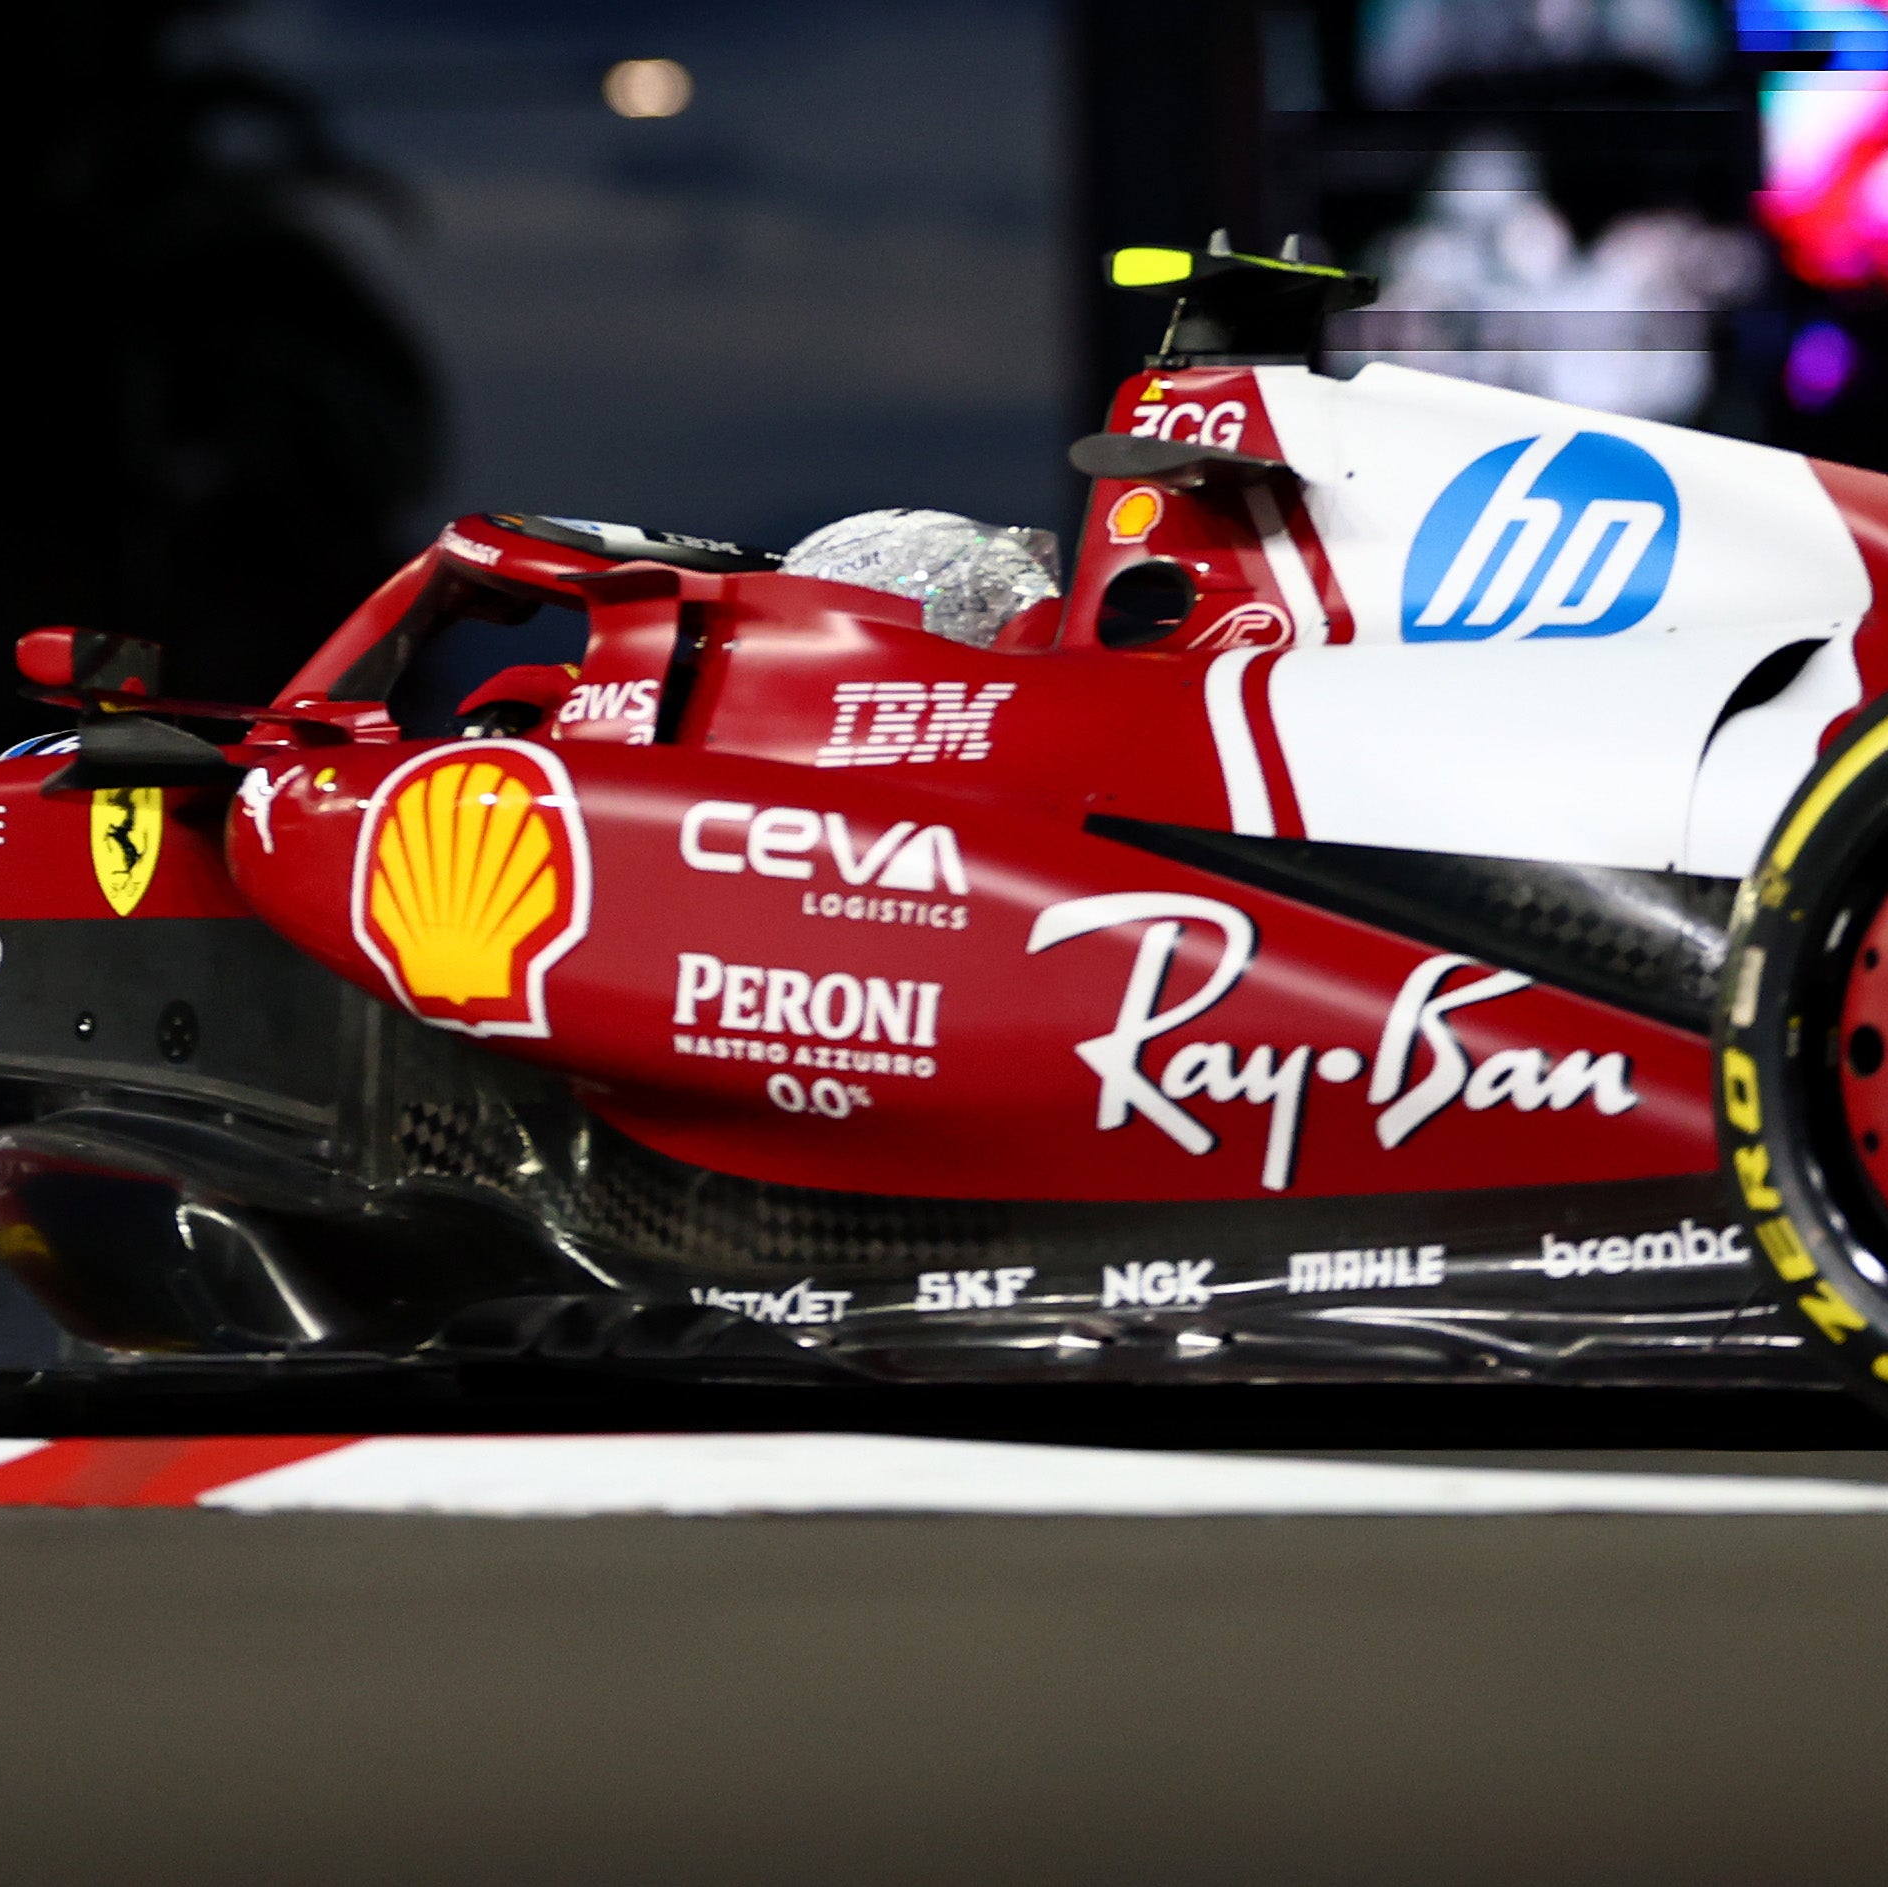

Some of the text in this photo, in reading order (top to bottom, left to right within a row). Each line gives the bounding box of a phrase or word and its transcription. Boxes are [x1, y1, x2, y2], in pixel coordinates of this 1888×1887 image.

[1413, 431, 1667, 643] hp
[559, 678, 660, 724] aws
[814, 682, 1018, 768] IBM
[801, 891, 970, 931] LOGISTICS
[672, 951, 943, 1048] PERONI
[673, 1034, 937, 1079] NASTRO AZZURRO
[1722, 1045, 1872, 1345] ZERO
[914, 1267, 1036, 1312] SKF
[1100, 1259, 1215, 1309] NGK
[1287, 1244, 1446, 1294] MAHLE
